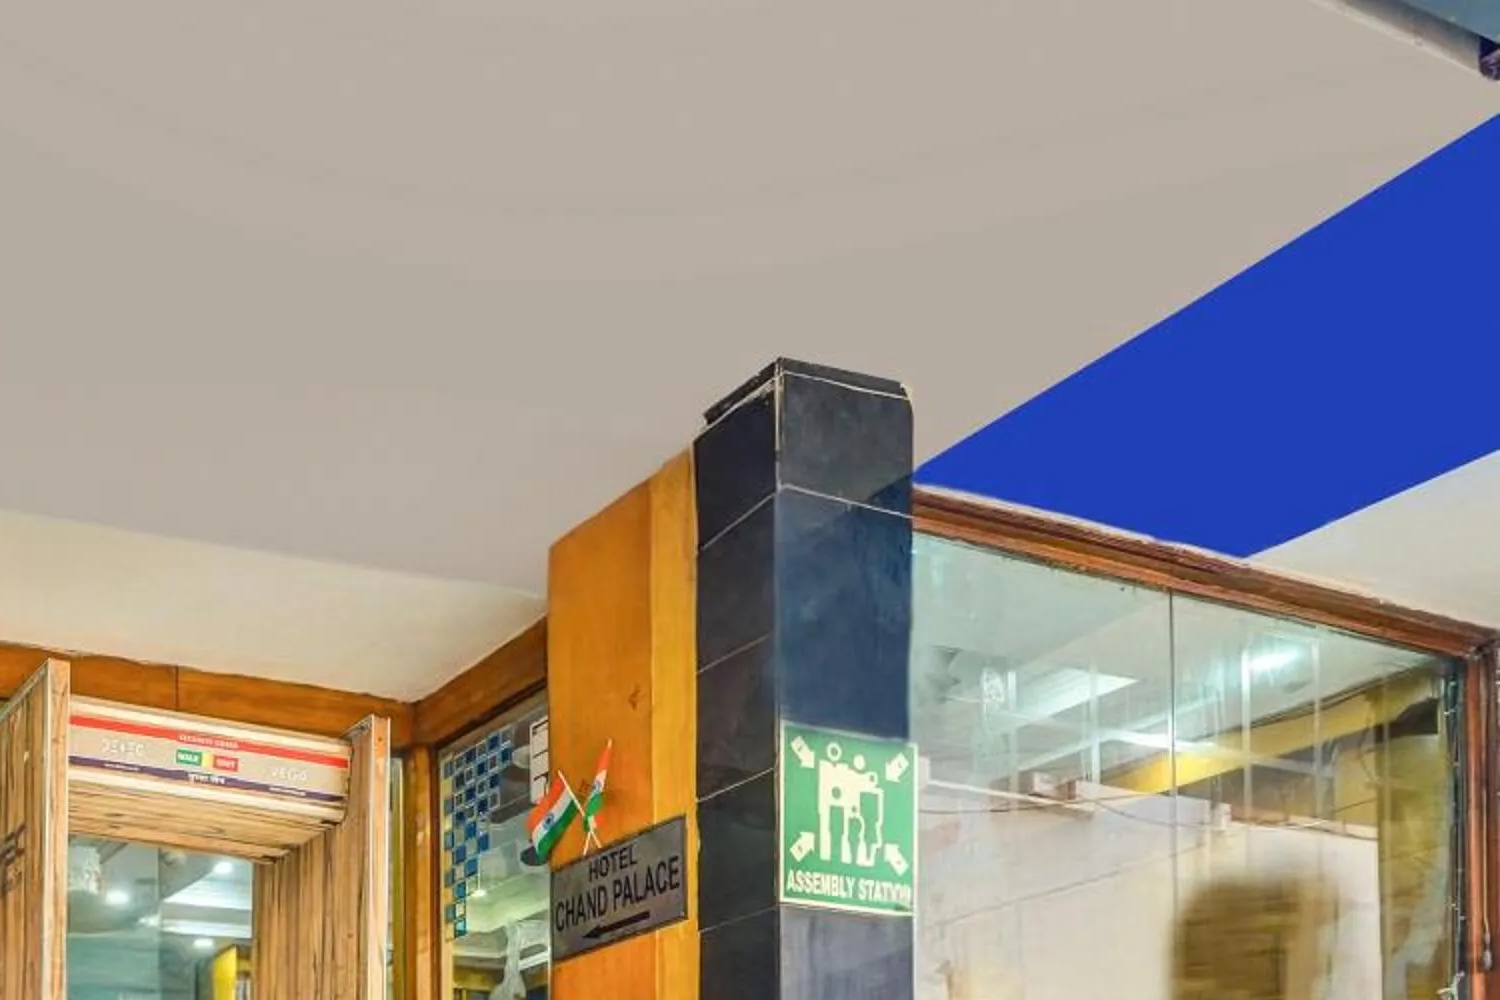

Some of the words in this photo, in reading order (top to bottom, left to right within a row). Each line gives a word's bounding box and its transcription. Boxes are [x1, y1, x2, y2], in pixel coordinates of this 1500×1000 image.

[589, 844, 637, 882] HOTEL
[555, 886, 607, 931] CHAND
[613, 855, 680, 911] PALACE
[787, 869, 855, 898] ASSEMBLY
[858, 877, 911, 903] STATION
